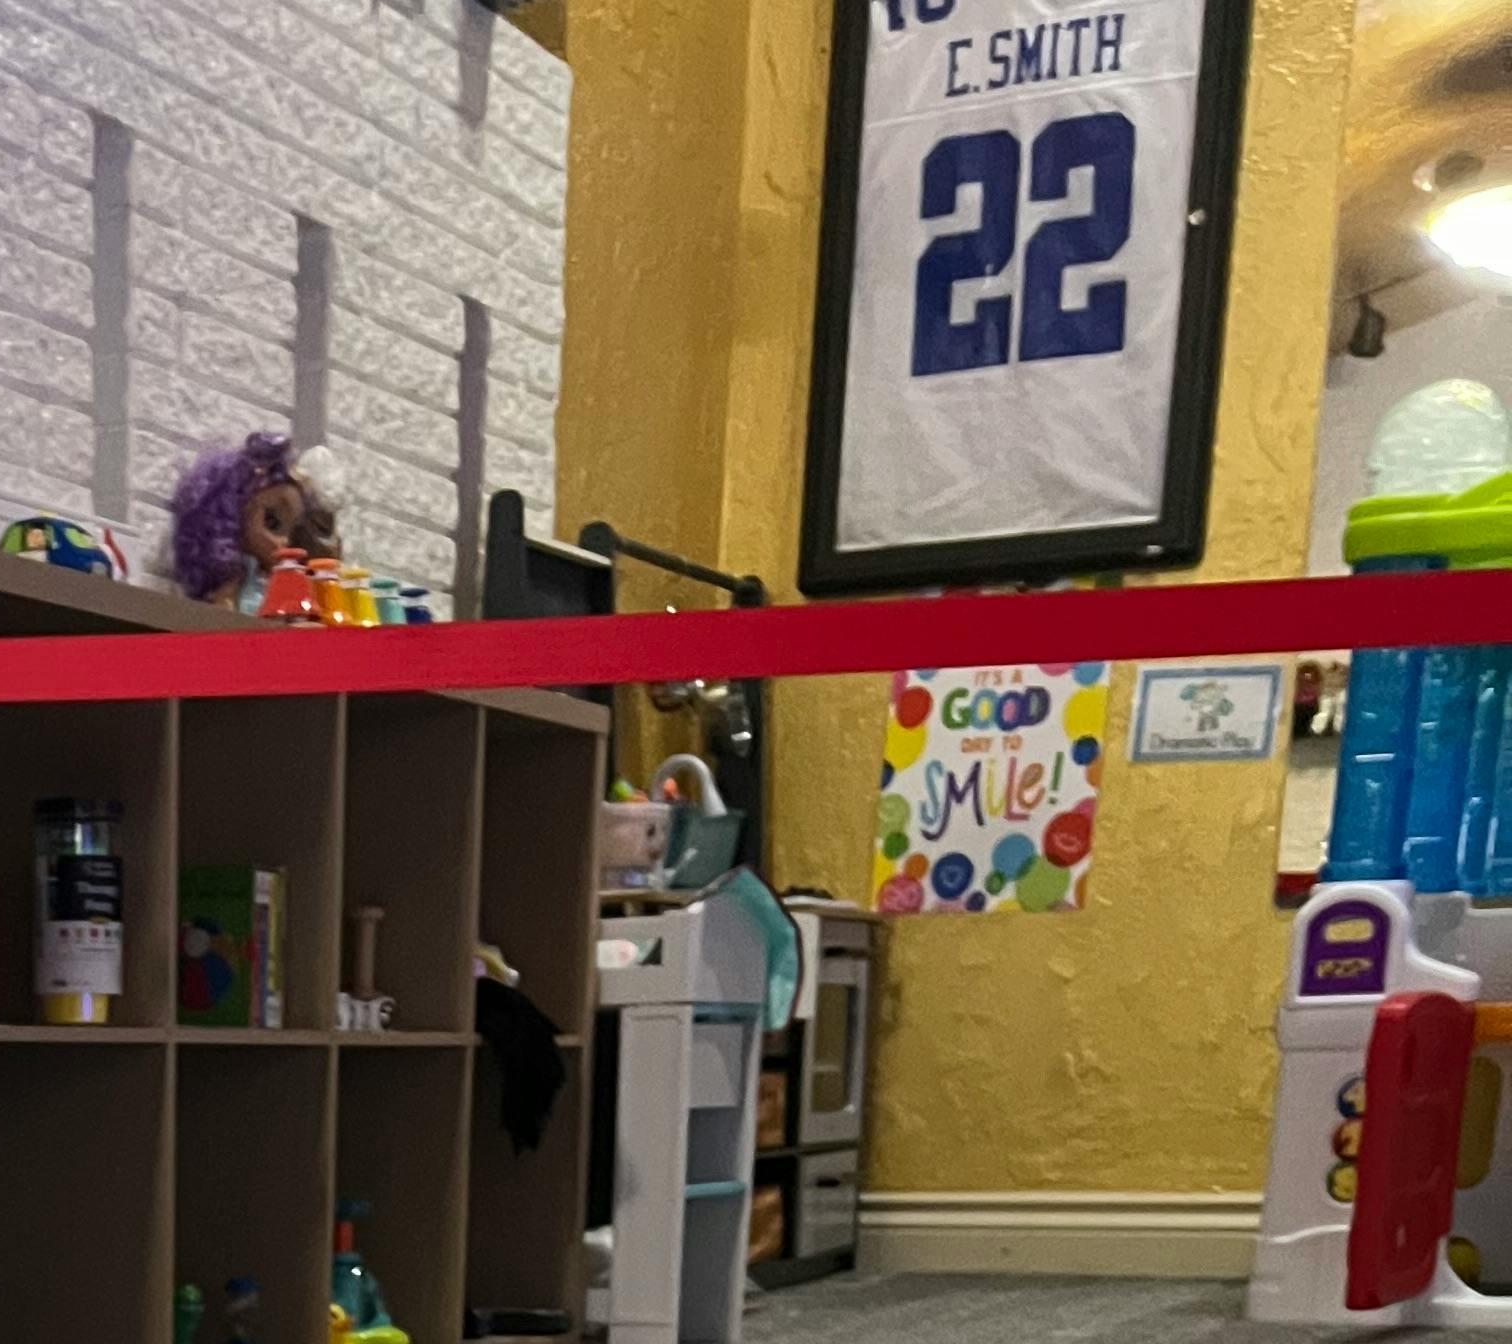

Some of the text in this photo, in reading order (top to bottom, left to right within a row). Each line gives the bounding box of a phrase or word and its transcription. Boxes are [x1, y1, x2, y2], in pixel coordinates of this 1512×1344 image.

[910, 110, 1136, 377] 22
[941, 685, 1051, 732] GOOD
[1001, 734, 1023, 753] TO
